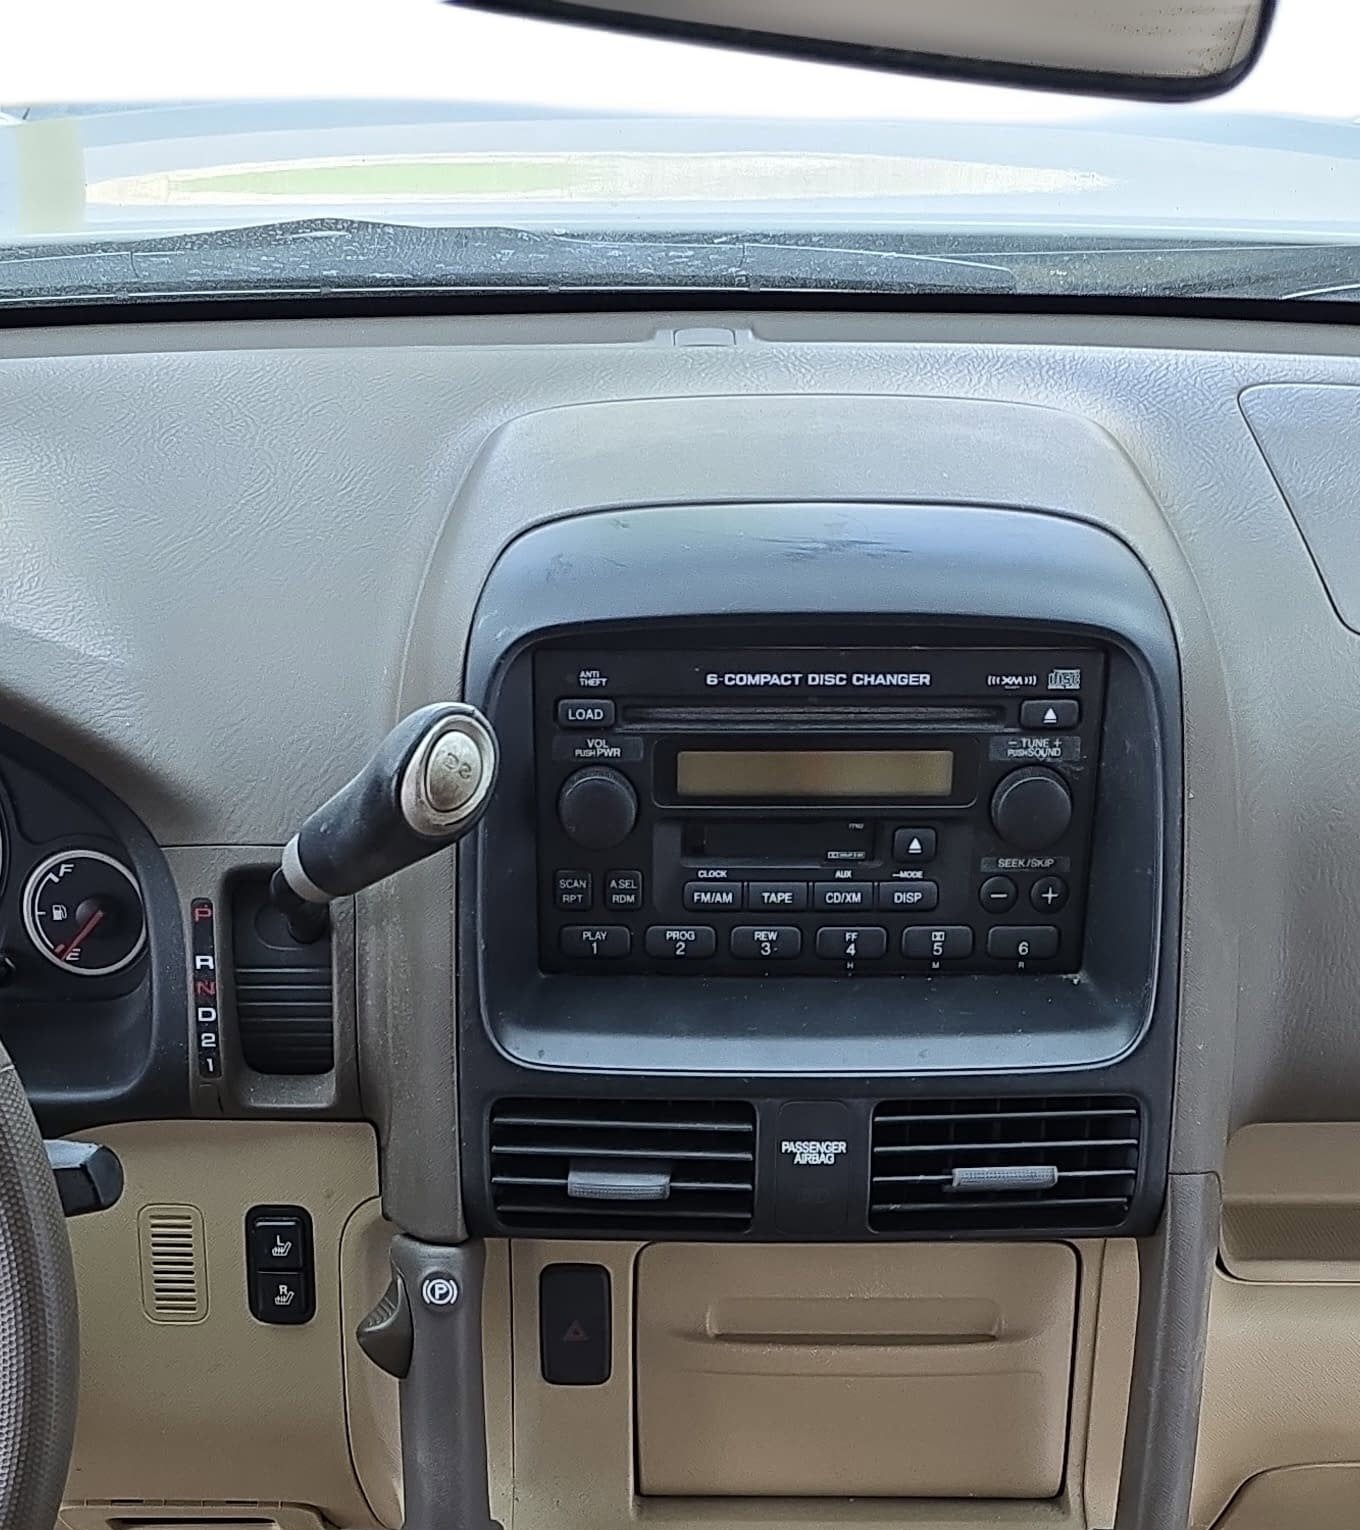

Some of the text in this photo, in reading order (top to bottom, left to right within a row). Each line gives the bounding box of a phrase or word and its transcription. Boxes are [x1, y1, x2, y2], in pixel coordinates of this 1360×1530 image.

[579, 677, 608, 687] THEFT
[706, 674, 930, 686] 6-COMPACT DISC CHANGER
[1001, 676, 1023, 685] XM
[568, 709, 603, 720] LOAD
[587, 739, 608, 748] VOL
[1021, 739, 1049, 748] TUNE
[596, 747, 621, 758] PWR
[1028, 747, 1061, 758] SOUND
[998, 859, 1054, 869] SEEK/SKIP
[59, 864, 74, 877] F
[698, 870, 727, 878] CLOCK
[835, 871, 852, 879] AUX
[559, 880, 587, 889] SCAN
[562, 894, 583, 903] RPT
[612, 894, 635, 904] RDM
[693, 892, 733, 903] FM/AM
[762, 892, 792, 903] TAPE
[826, 892, 861, 904] CD/XM
[894, 892, 922, 903] DISP
[583, 931, 607, 941] PLAY
[666, 931, 695, 941] PROG
[754, 931, 778, 941] REW
[846, 932, 858, 942] FF
[591, 943, 598, 955] 1
[676, 944, 685, 955] 2
[761, 943, 771, 955] 3
[846, 943, 856, 956] 4
[933, 943, 942, 955] 5
[1018, 942, 1029, 955] 6
[66, 948, 81, 961] E
[194, 908, 216, 1072] P R N D 2 1
[781, 1142, 847, 1153] PASSENGER
[794, 1153, 835, 1165] AIRBAG
[277, 1235, 283, 1246] L
[279, 1285, 288, 1295] R
